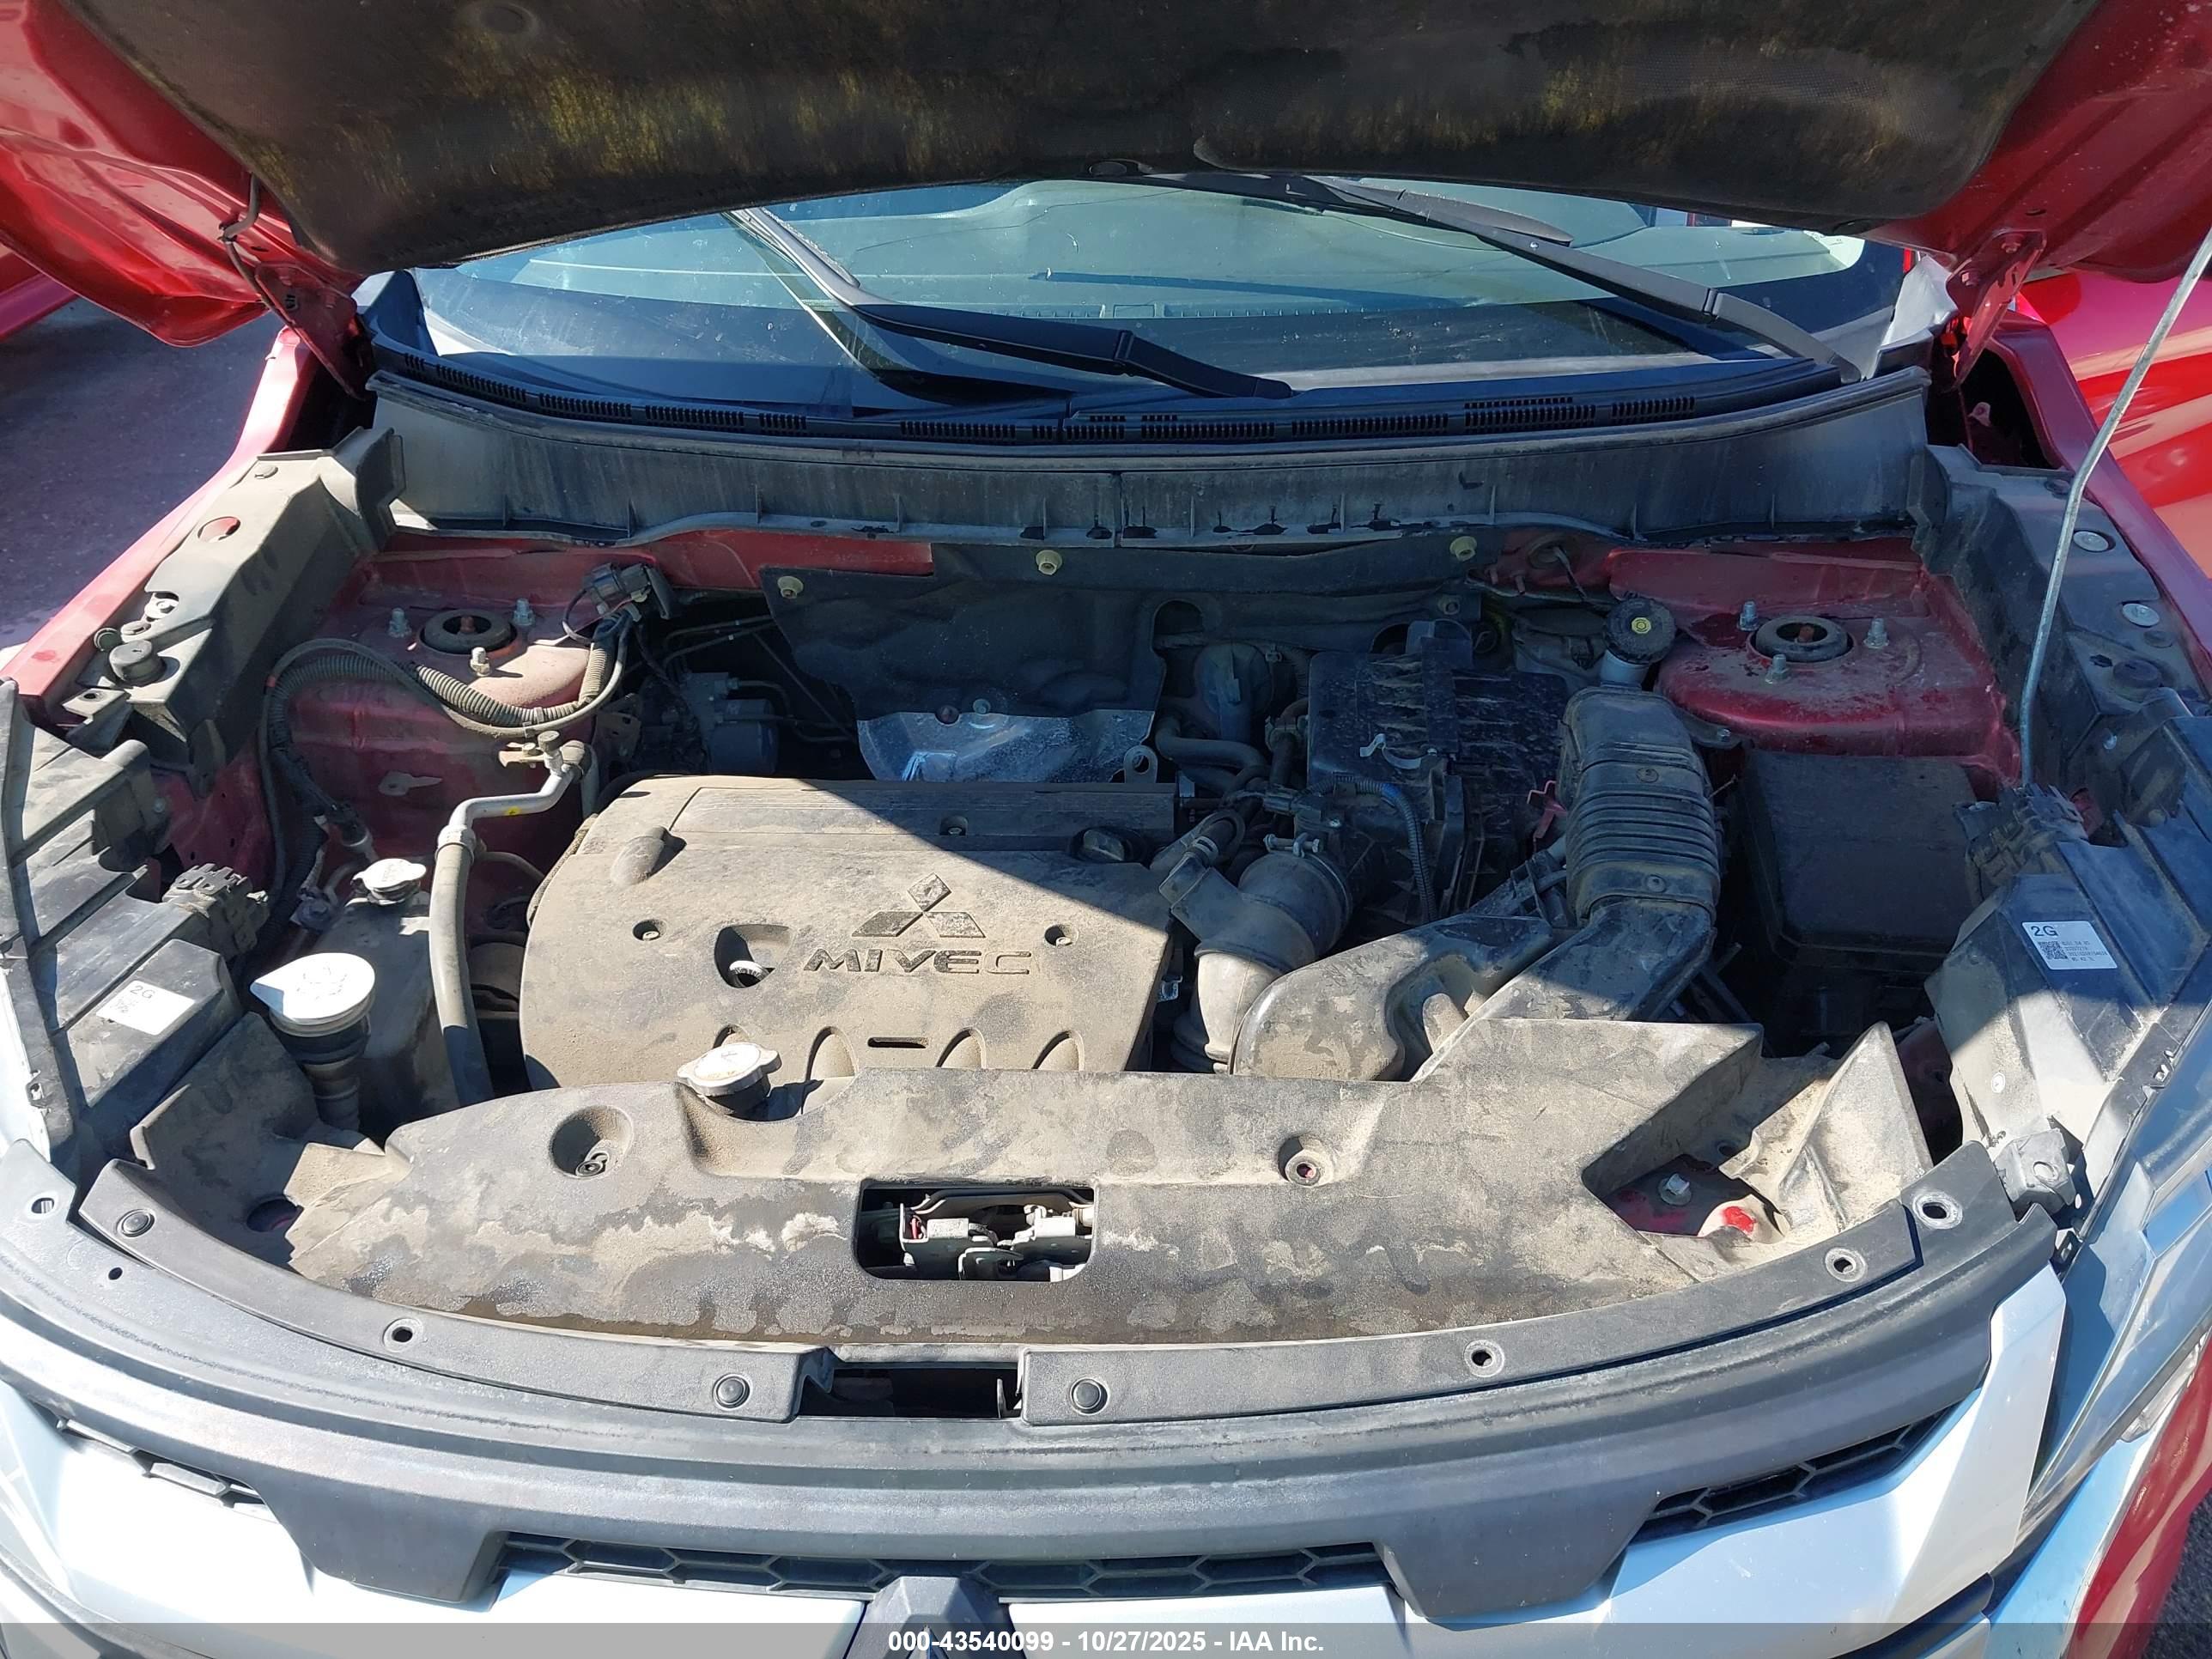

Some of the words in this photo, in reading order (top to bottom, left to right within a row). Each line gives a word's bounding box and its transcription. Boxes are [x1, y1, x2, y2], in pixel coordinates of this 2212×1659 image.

[2030, 925, 2059, 938] 2G
[803, 947, 1032, 975] MIVEC
[130, 984, 156, 1000] 2G
